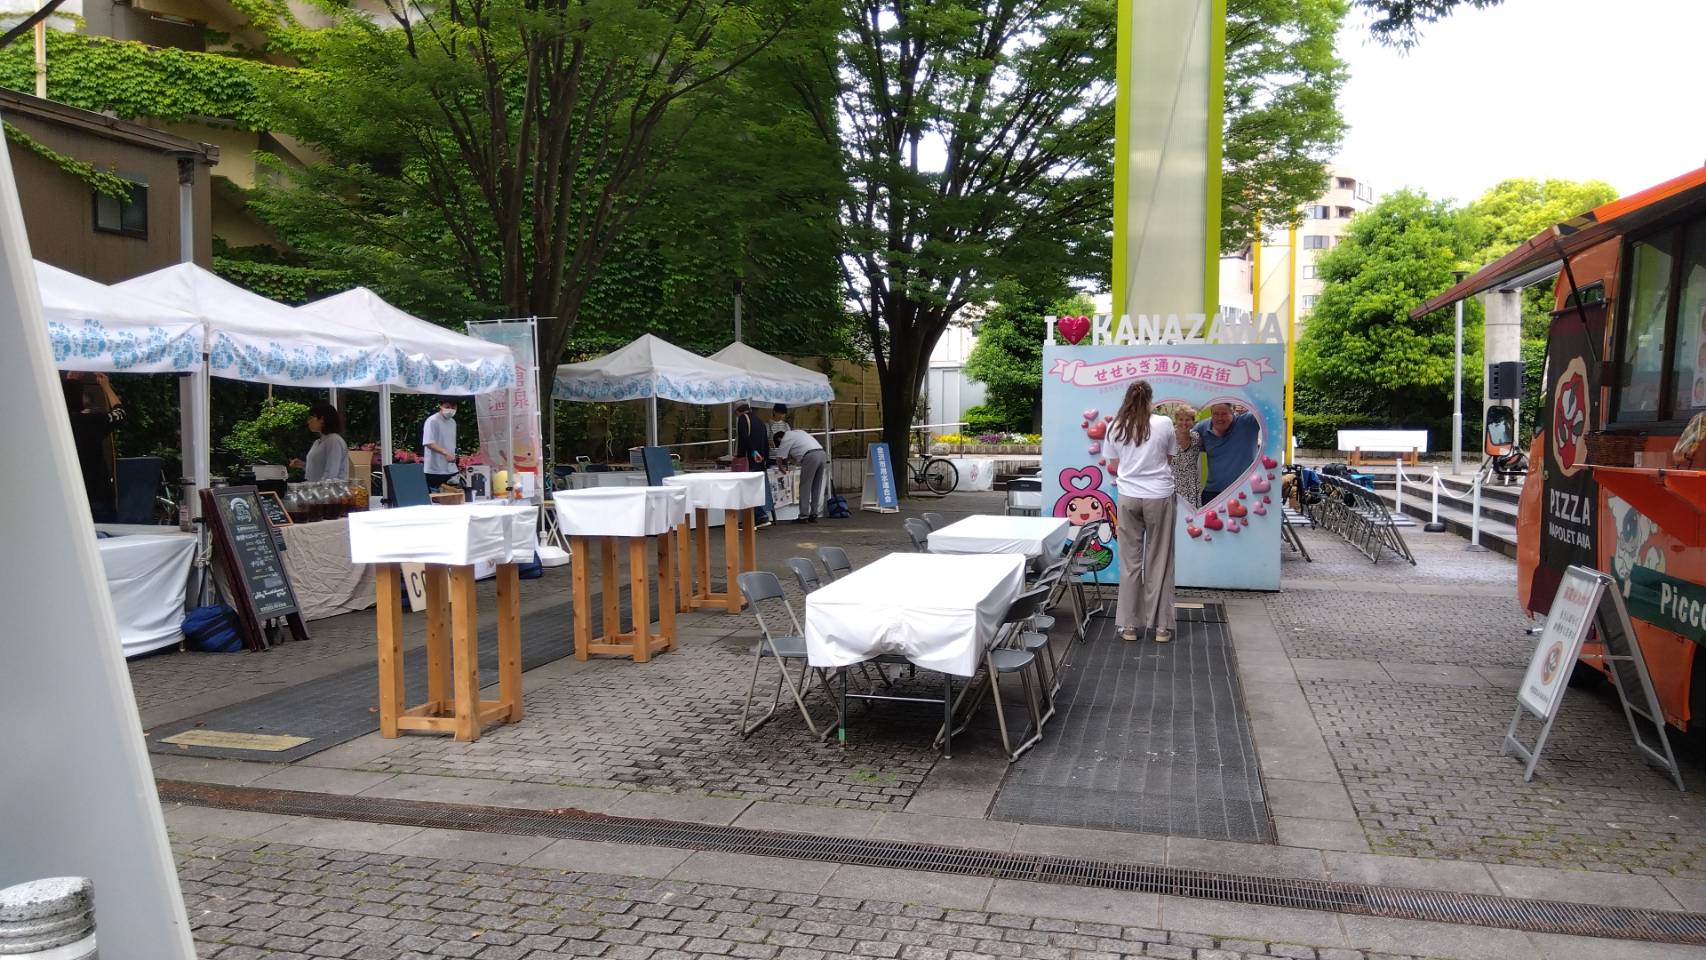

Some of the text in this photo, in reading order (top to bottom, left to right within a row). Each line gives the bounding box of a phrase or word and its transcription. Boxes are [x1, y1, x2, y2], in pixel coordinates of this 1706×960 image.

[1044, 312, 1284, 345] I KANAZAWA
[1094, 358, 1232, 383] せせらぎ通り商店街
[1549, 488, 1591, 527] PIZZA
